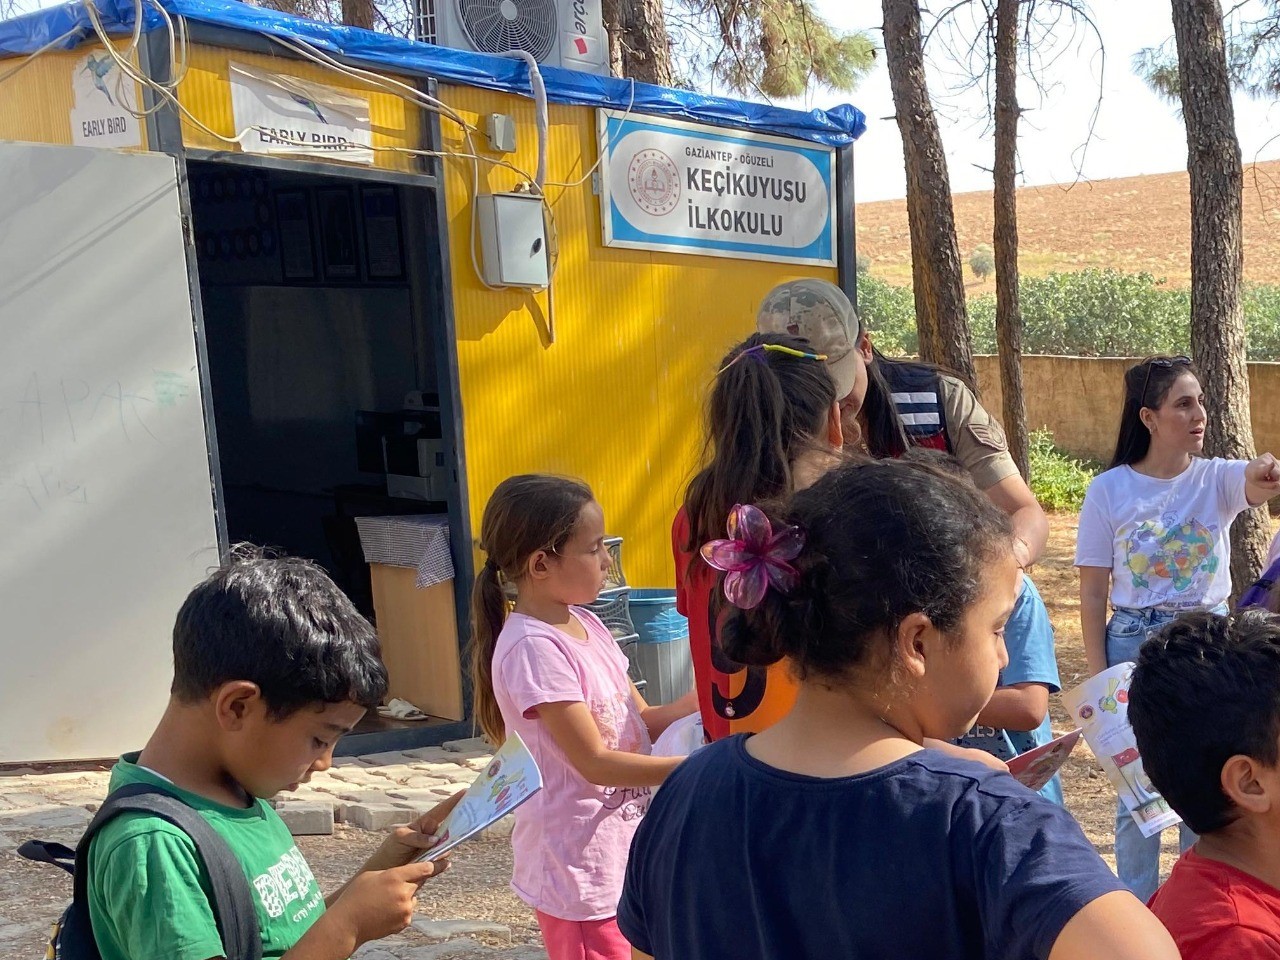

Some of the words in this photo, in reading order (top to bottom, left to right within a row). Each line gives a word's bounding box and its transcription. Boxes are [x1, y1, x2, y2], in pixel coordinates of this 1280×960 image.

[82, 119, 106, 137] EARLY
[107, 116, 127, 134] BIRD
[685, 146, 733, 162] GAZİANTEP
[740, 152, 774, 168] OĞUZELİ
[686, 166, 806, 204] KEÇİKUYUSU
[688, 198, 783, 237] İLKOKULU
